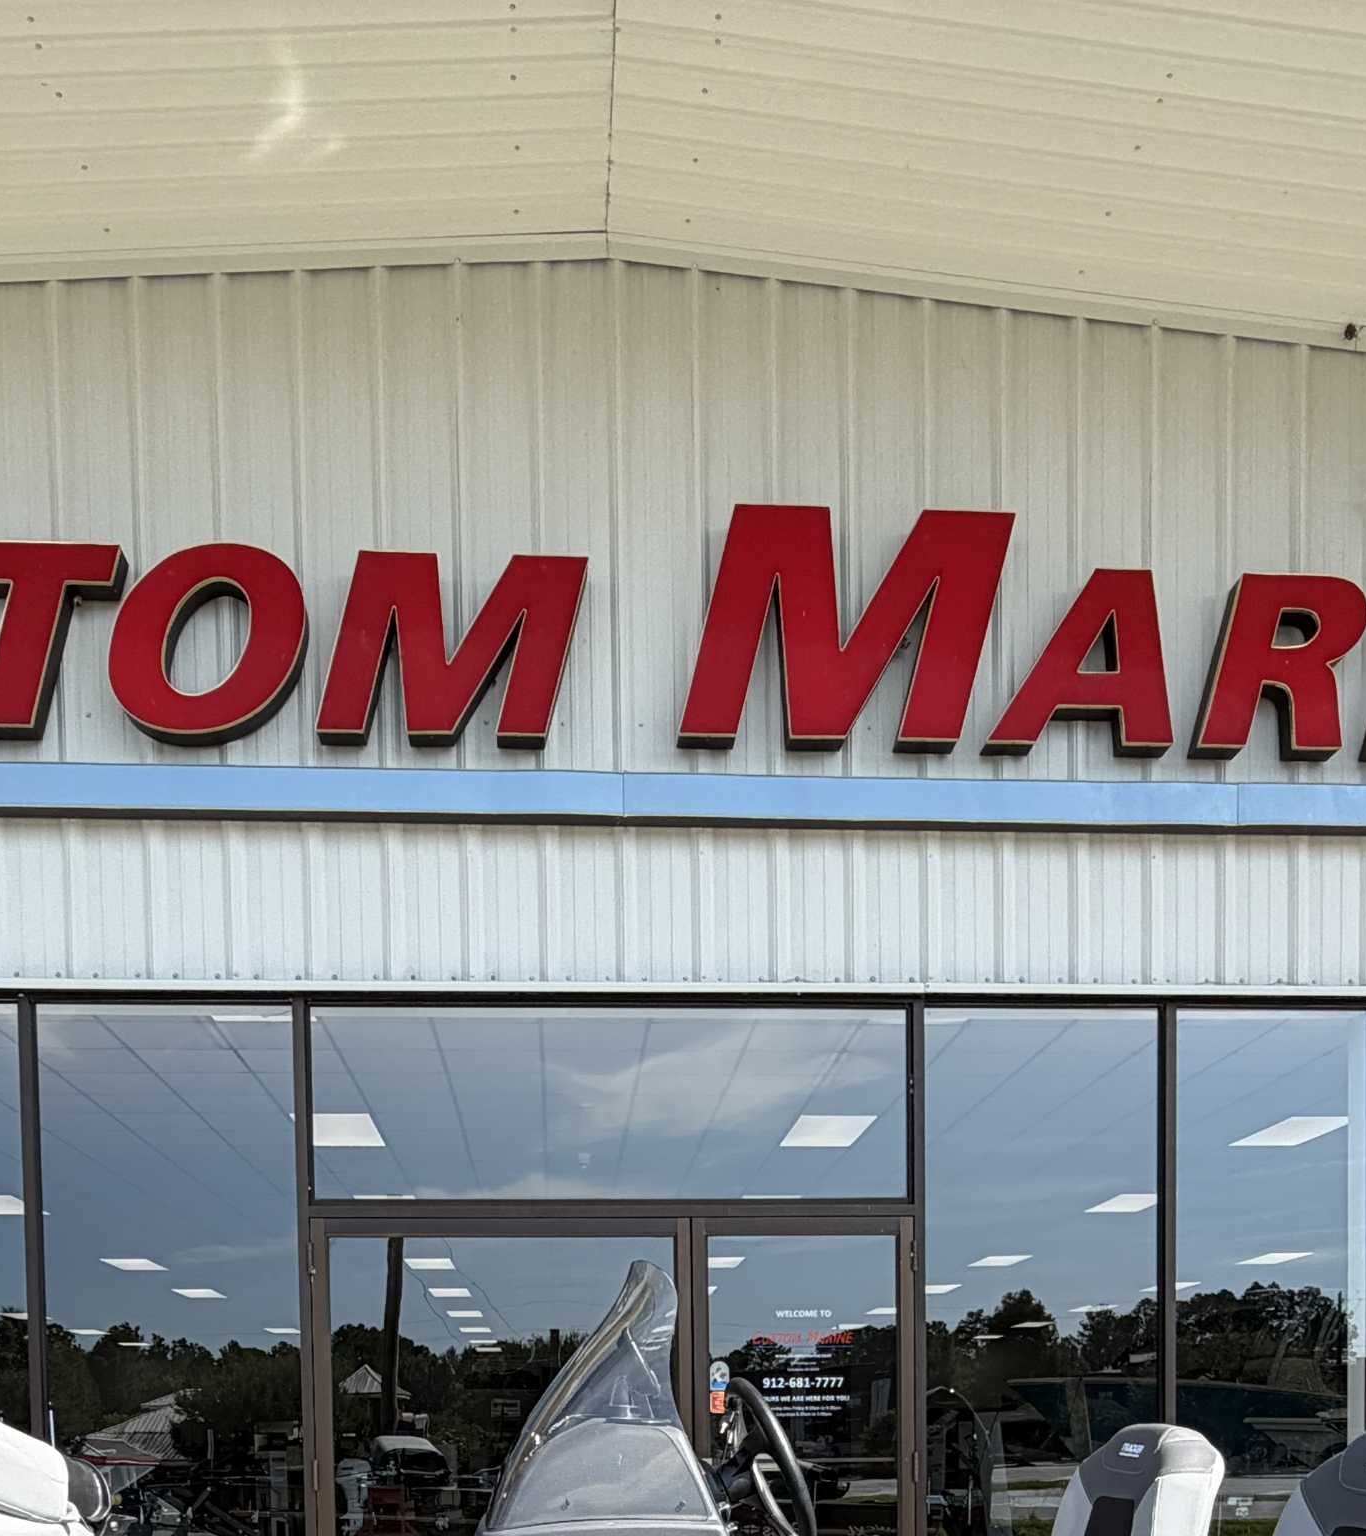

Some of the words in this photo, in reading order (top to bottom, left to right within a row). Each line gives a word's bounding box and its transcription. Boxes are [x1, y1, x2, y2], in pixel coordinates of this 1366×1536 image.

[775, 1309, 817, 1318] WELCOME
[820, 1309, 832, 1318] TO
[763, 1376, 844, 1388] 912-681-7777
